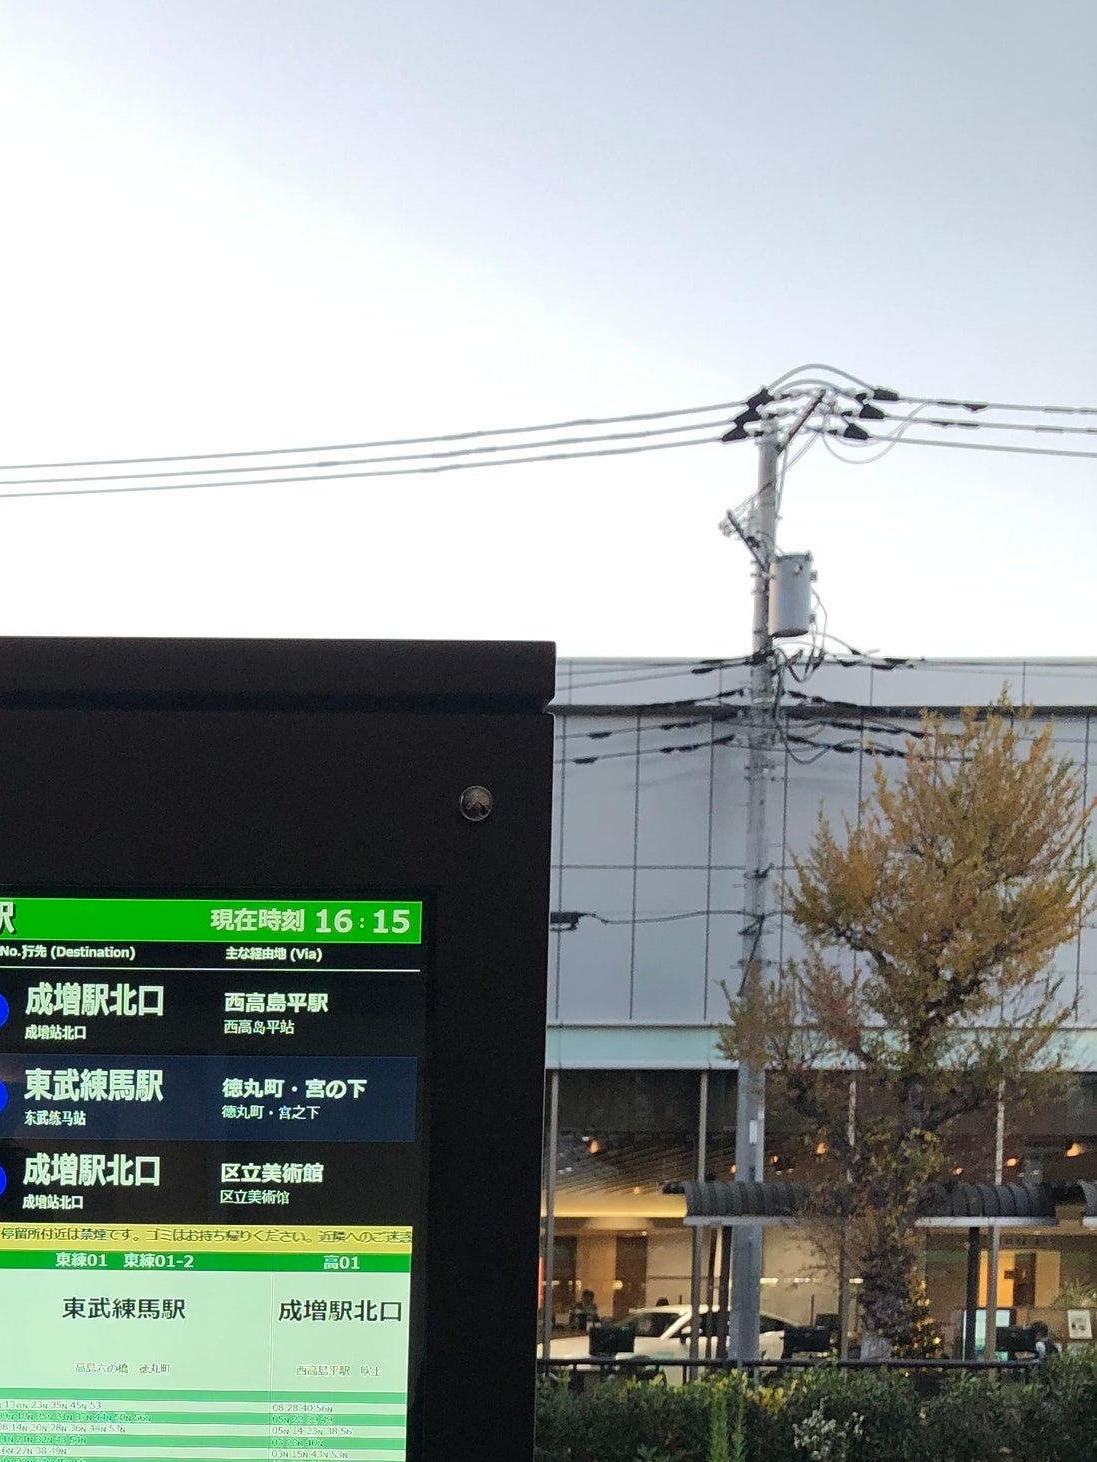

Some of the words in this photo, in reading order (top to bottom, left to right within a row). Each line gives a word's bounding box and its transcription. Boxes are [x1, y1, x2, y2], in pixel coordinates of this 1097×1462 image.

[211, 908, 305, 932] 現在時刻
[315, 908, 411, 934] 16:15
[51, 946, 136, 960] (Destination)
[225, 947, 286, 961] 主な経由地
[290, 948, 323, 963] (Via)
[25, 982, 164, 1016] 成増駅北口
[224, 992, 329, 1013] 西高島平駅
[224, 1019, 295, 1035] 西高岛平站
[24, 1068, 164, 1102] 東武練馬駅
[222, 1078, 368, 1099] 徳丸町・宮の下
[24, 1109, 87, 1126] 东武练马站
[23, 1152, 161, 1186] 成増駅北口
[220, 1162, 324, 1184] 区立美術館
[55, 1252, 108, 1267] 東練01
[123, 1253, 194, 1269] 東練01-2
[323, 1255, 360, 1270] 高01
[62, 1296, 186, 1320] 東武練馬駅
[278, 1299, 402, 1322] 成増駅北口
